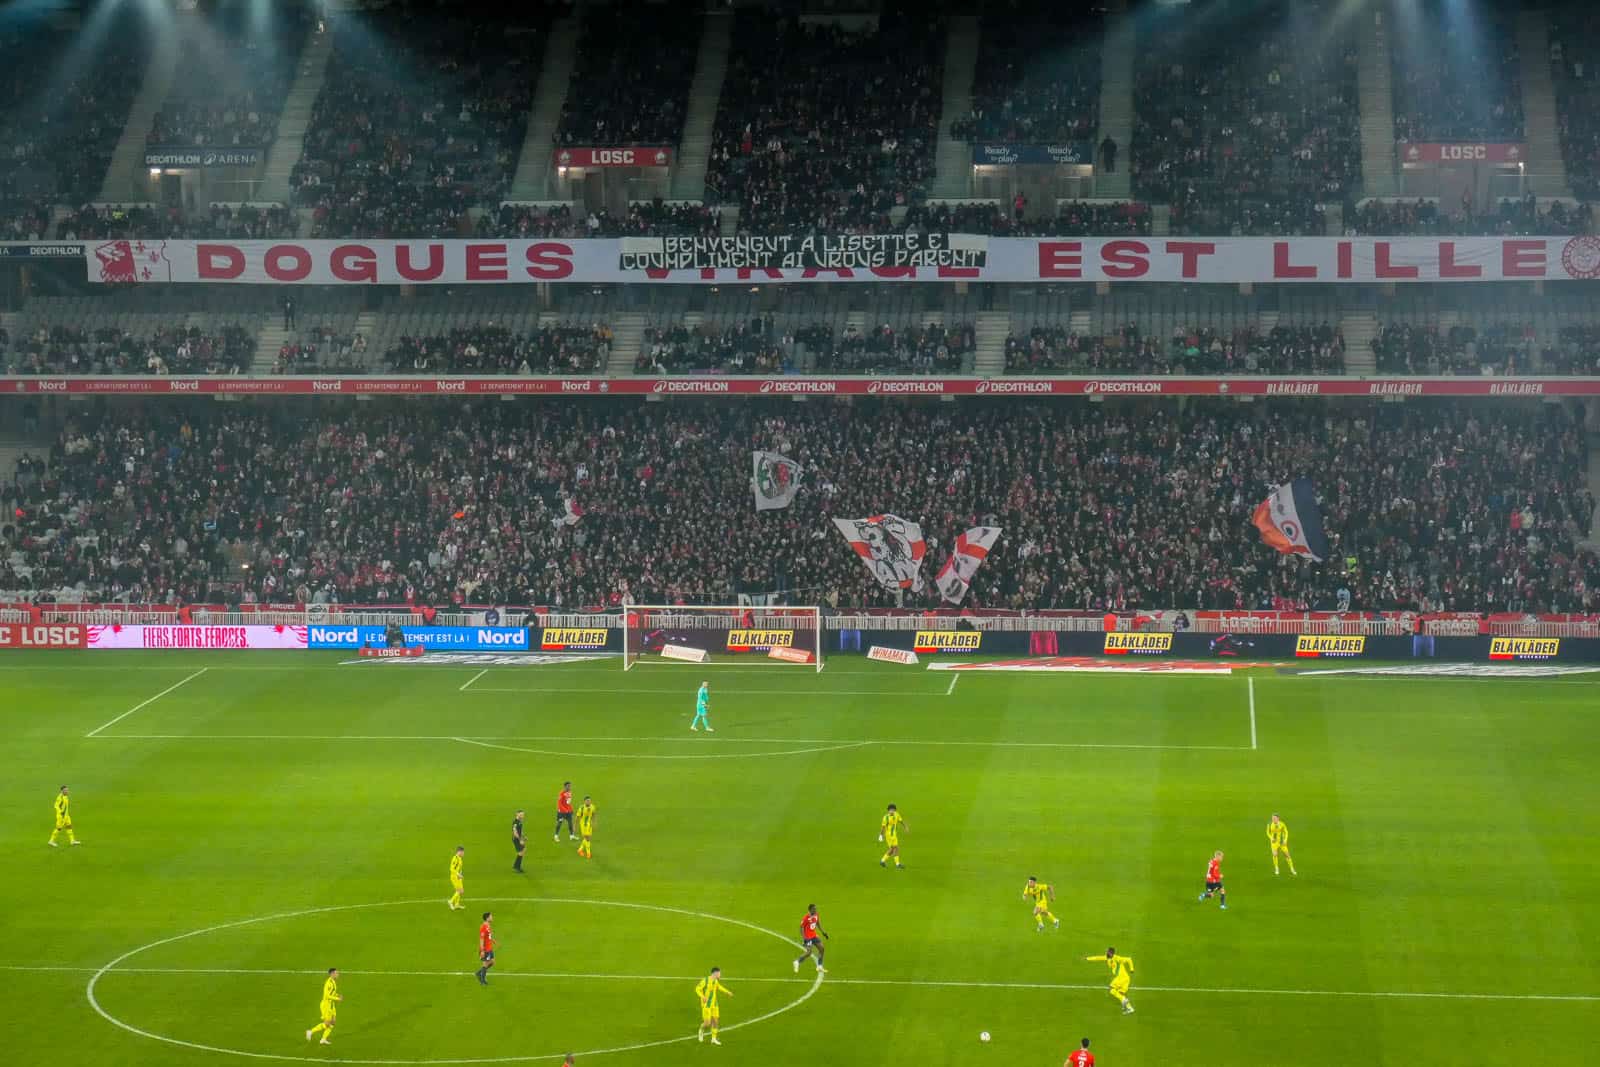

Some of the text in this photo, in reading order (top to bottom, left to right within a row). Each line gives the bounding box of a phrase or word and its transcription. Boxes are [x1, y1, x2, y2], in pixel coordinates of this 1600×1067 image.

[592, 150, 635, 164] LOSC
[1441, 145, 1486, 159] LOSC
[145, 155, 257, 164] DECATHLON ARENA
[800, 235, 814, 251] A
[823, 233, 919, 251] LISETTE
[928, 233, 942, 250] E
[29, 247, 81, 255] DECATHLON
[197, 242, 574, 283] DOGUES
[894, 249, 981, 267] PARENT
[1038, 241, 1215, 278] EST
[1273, 240, 1547, 278] LILLE
[39, 381, 67, 390] Nord
[170, 381, 199, 390] Nord
[313, 381, 342, 390] Nord
[436, 381, 465, 390] Nord
[561, 381, 591, 390] Nord
[668, 382, 729, 392] DECATHLON
[775, 382, 836, 392] DECATHLON
[882, 382, 944, 392] DECATHLON
[990, 382, 1052, 392] DECATHLON
[1099, 383, 1161, 392] DECATHLON
[21, 626, 80, 645] LOSC
[311, 627, 358, 642] Nord
[365, 633, 377, 642] LE
[436, 633, 452, 643] EST
[477, 629, 525, 645] Nord
[544, 629, 605, 644] BLÅKLÄDER
[917, 632, 978, 647] BLÅKLÄDER
[1107, 633, 1170, 648] BLÅKLÄDER
[1300, 636, 1362, 651] BLÅKLÄDER
[1493, 638, 1557, 653] BLÅKLÄDER
[378, 648, 401, 657] LOSC
